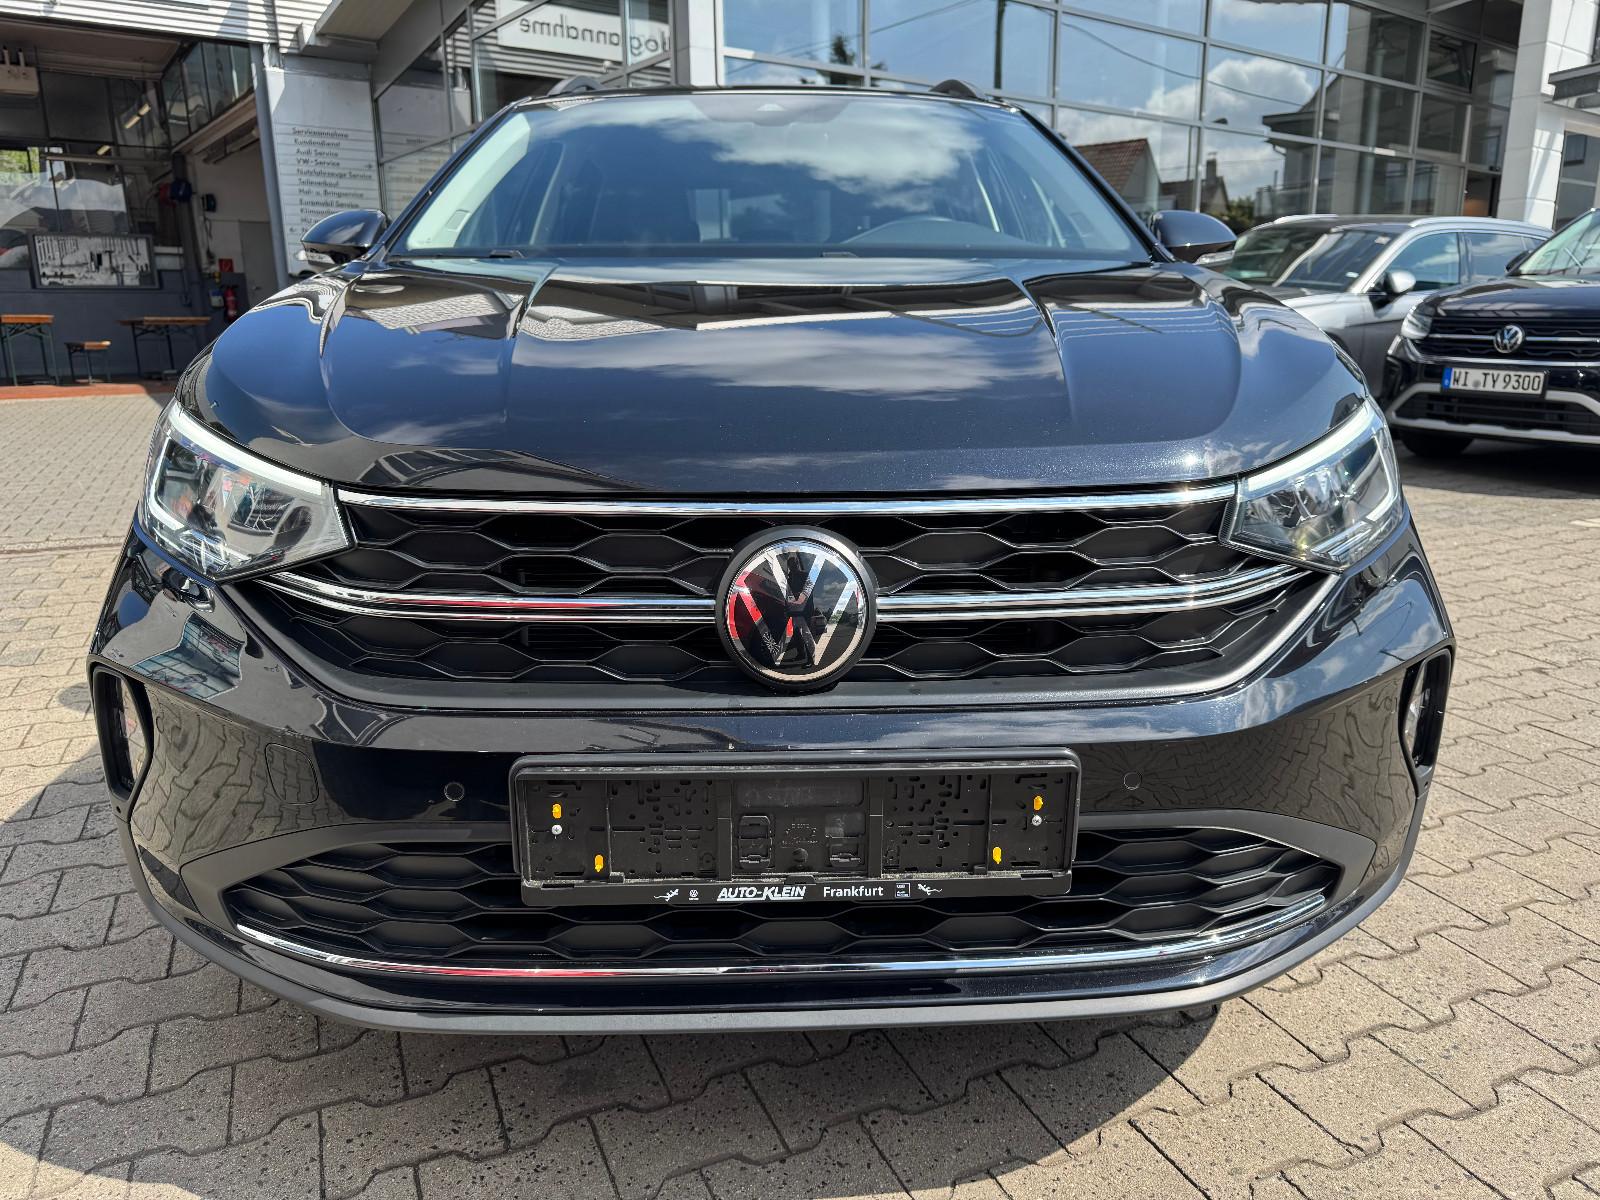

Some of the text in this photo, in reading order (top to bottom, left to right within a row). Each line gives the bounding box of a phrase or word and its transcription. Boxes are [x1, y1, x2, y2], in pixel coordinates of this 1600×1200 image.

[313, 148, 339, 157] Service
[348, 171, 373, 180] Service
[1453, 370, 1470, 388] WI
[717, 885, 807, 901] AUTO-KLEIN
[822, 886, 884, 898] Frankfurt
